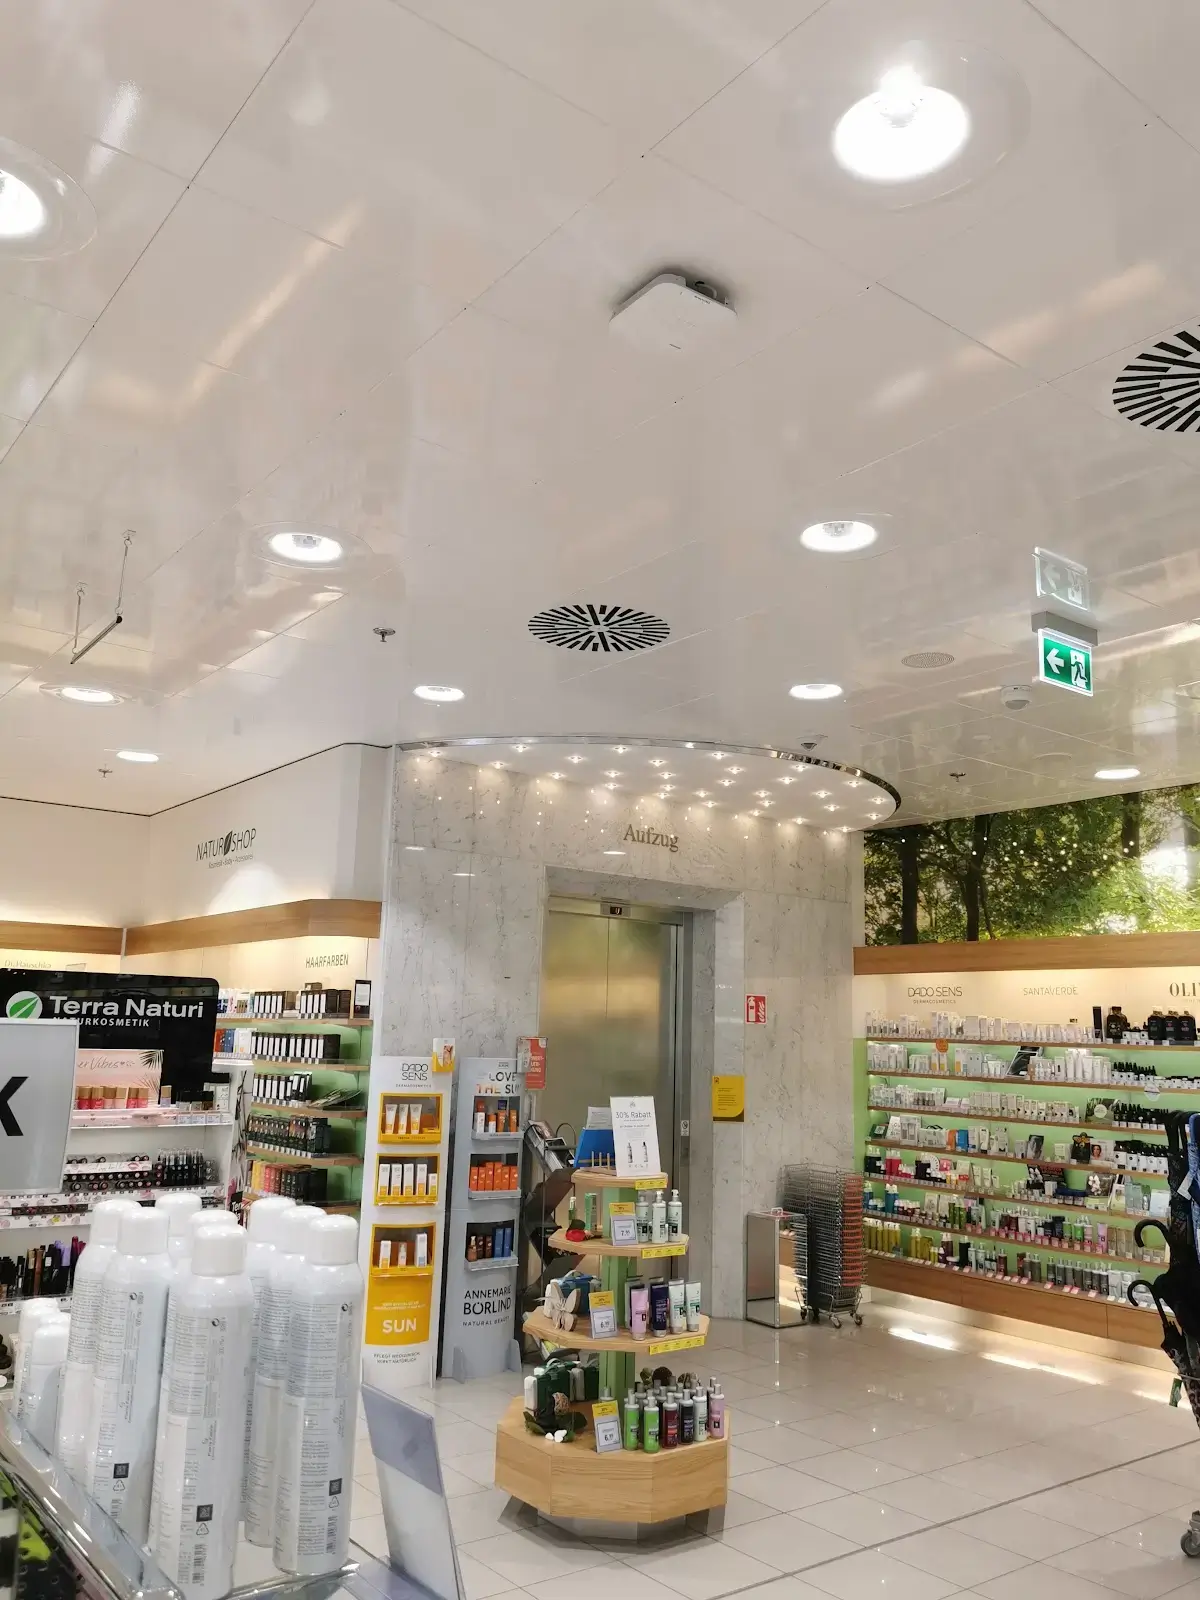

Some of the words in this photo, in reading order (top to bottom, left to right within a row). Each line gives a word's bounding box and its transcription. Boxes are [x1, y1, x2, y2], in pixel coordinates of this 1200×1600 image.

[623, 824, 679, 853] Aufzug
[305, 953, 349, 969] HAARFARBEN
[907, 986, 934, 998] DADO
[935, 986, 963, 997] SENS
[1023, 985, 1079, 996] SANTAVERDE
[49, 995, 119, 1015] Terra
[125, 998, 204, 1018] Naturi
[401, 1063, 429, 1073] DADO
[401, 1071, 428, 1081] SENS
[488, 1071, 517, 1082] LOVE
[476, 1083, 502, 1094] THE
[615, 1110, 630, 1119] 30%
[630, 1110, 652, 1119] Rabatt
[382, 1318, 417, 1334] SUN
[462, 1319, 493, 1327] NATURAL
